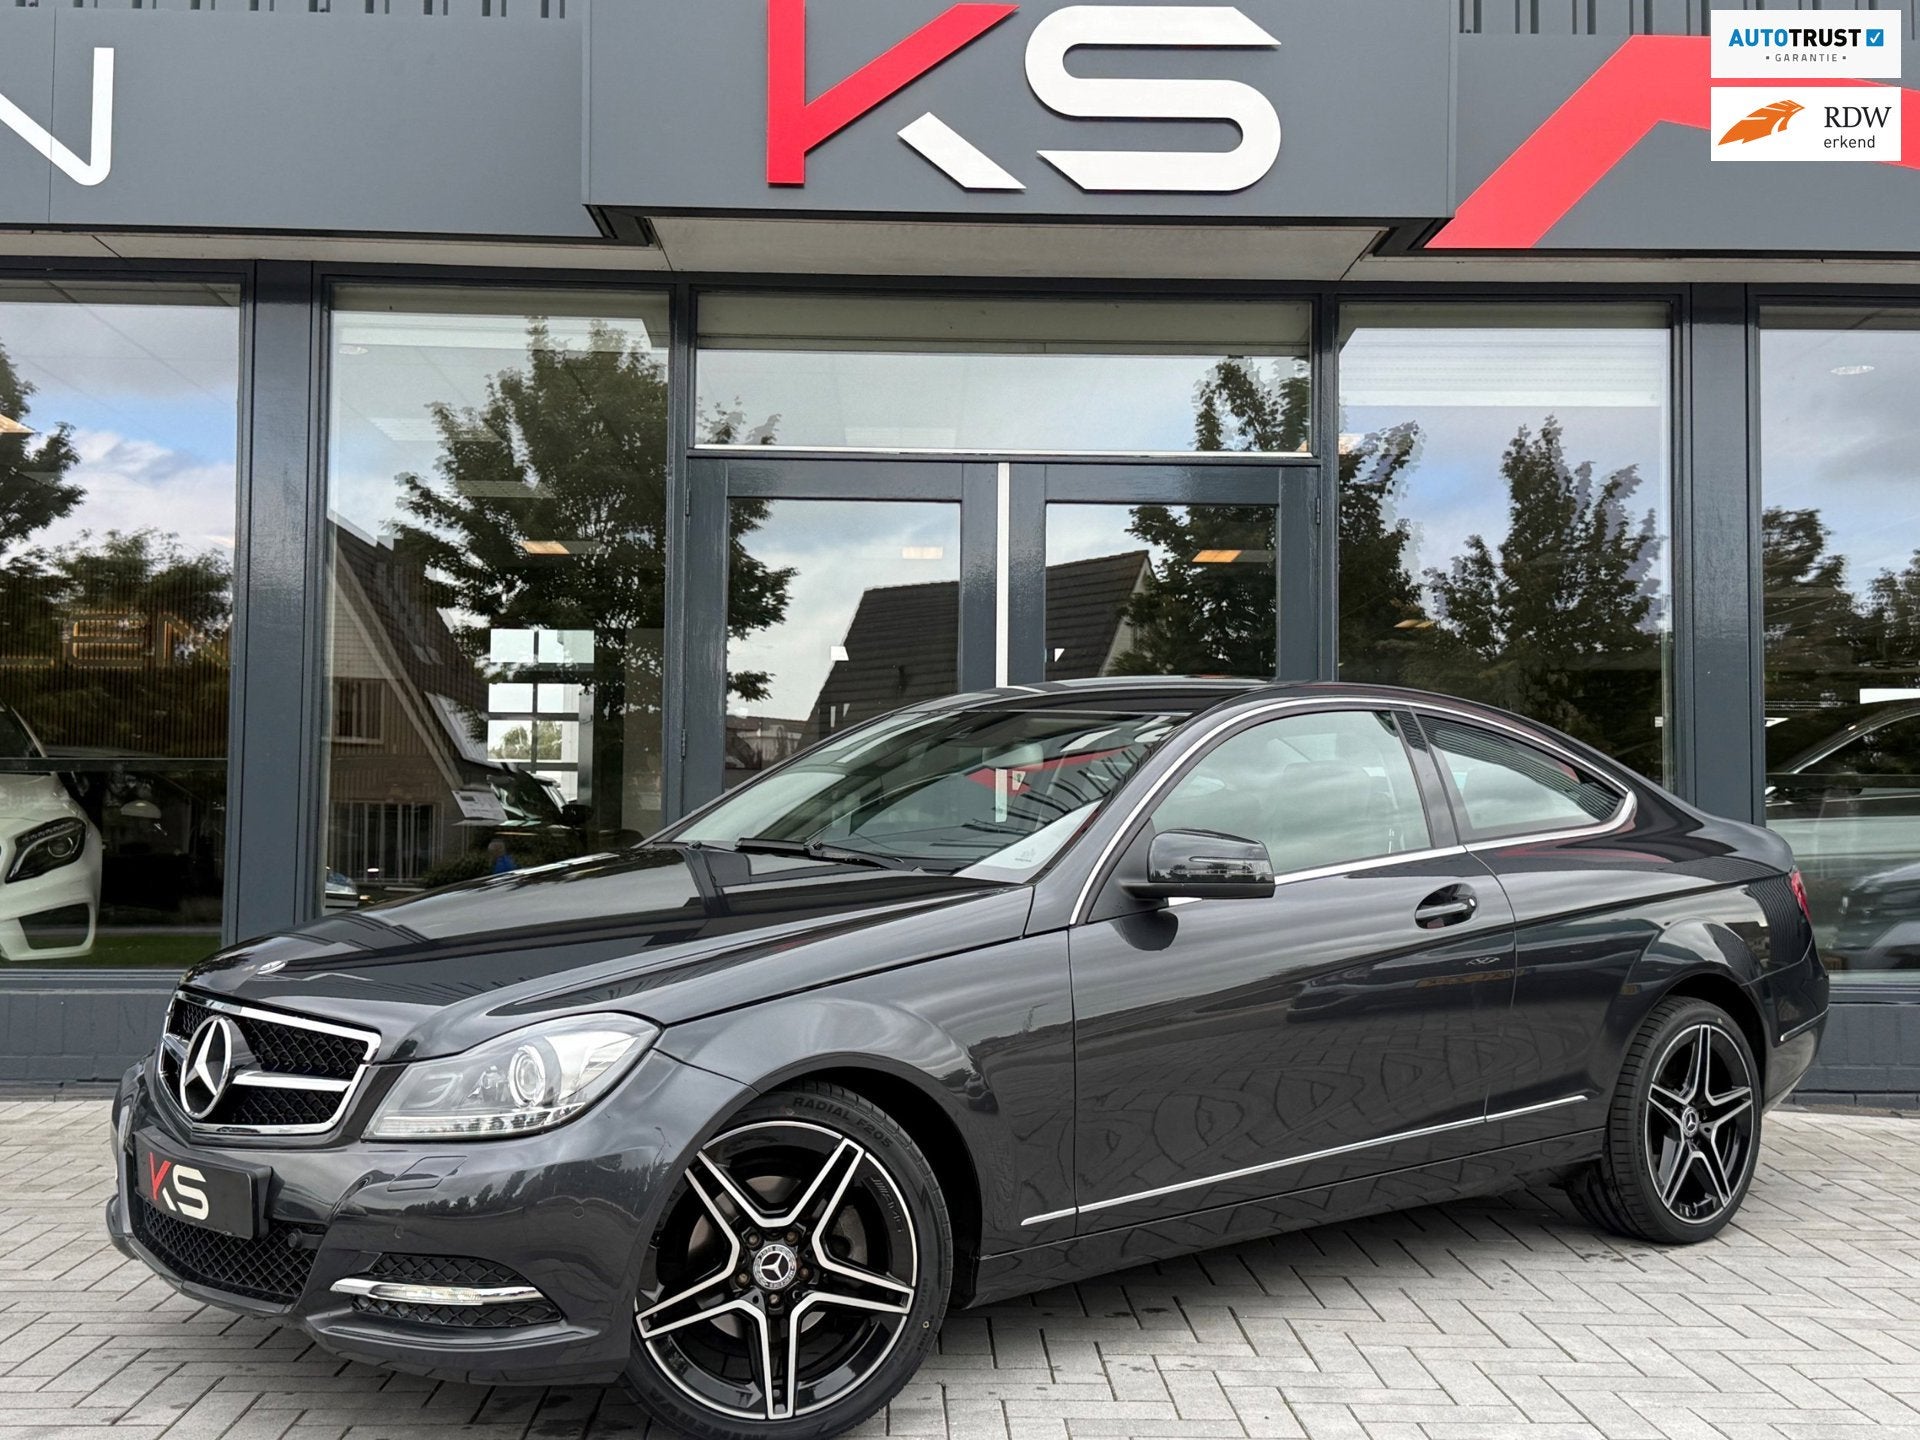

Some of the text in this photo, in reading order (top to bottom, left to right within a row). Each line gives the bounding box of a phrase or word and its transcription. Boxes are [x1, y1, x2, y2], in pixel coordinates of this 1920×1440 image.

[766, 0, 1281, 192] KS
[792, 1096, 894, 1149] RADIAL F205
[148, 1151, 210, 1220] KS
